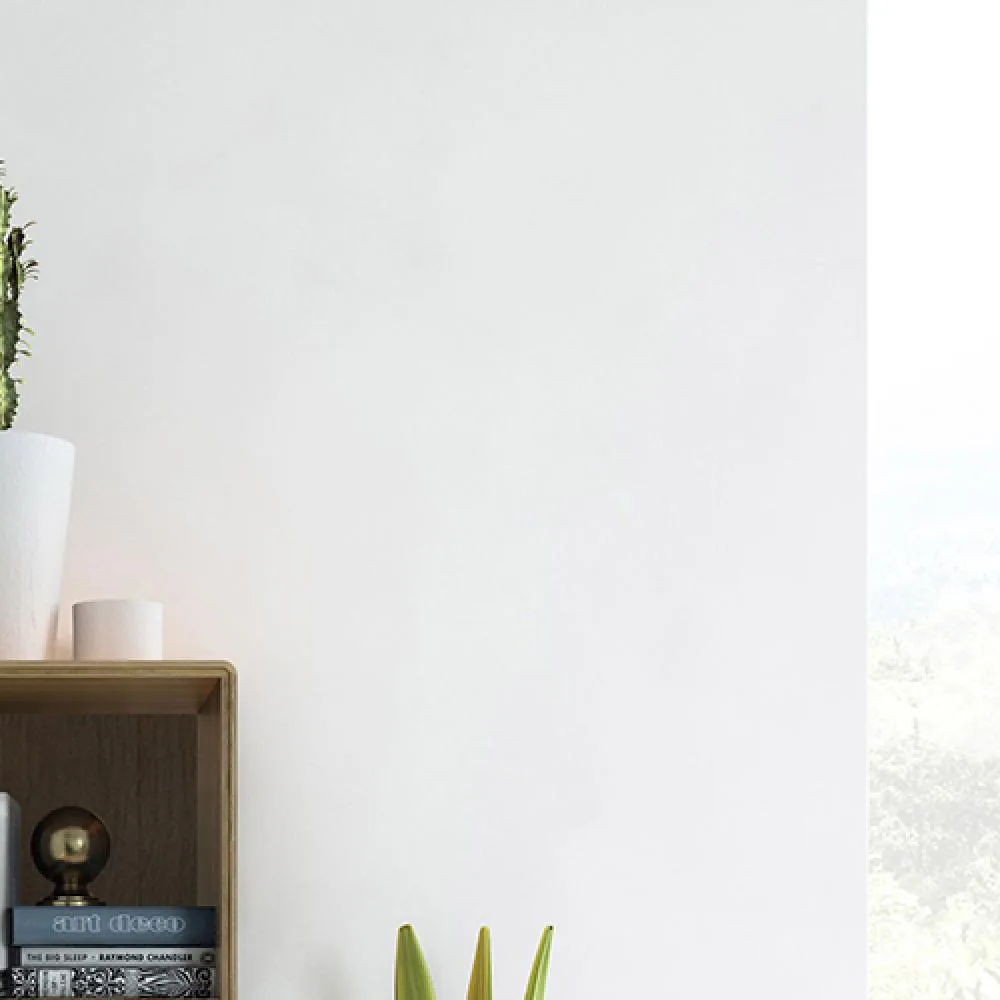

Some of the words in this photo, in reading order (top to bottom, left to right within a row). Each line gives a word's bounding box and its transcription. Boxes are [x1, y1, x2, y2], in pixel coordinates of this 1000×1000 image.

[52, 913, 101, 933] art
[109, 913, 187, 933] deco
[27, 953, 42, 961] THE
[45, 953, 61, 961] BIG
[63, 953, 88, 961] SLEEP
[99, 953, 145, 961] RAYMOND
[147, 953, 193, 961] CHANDLER
